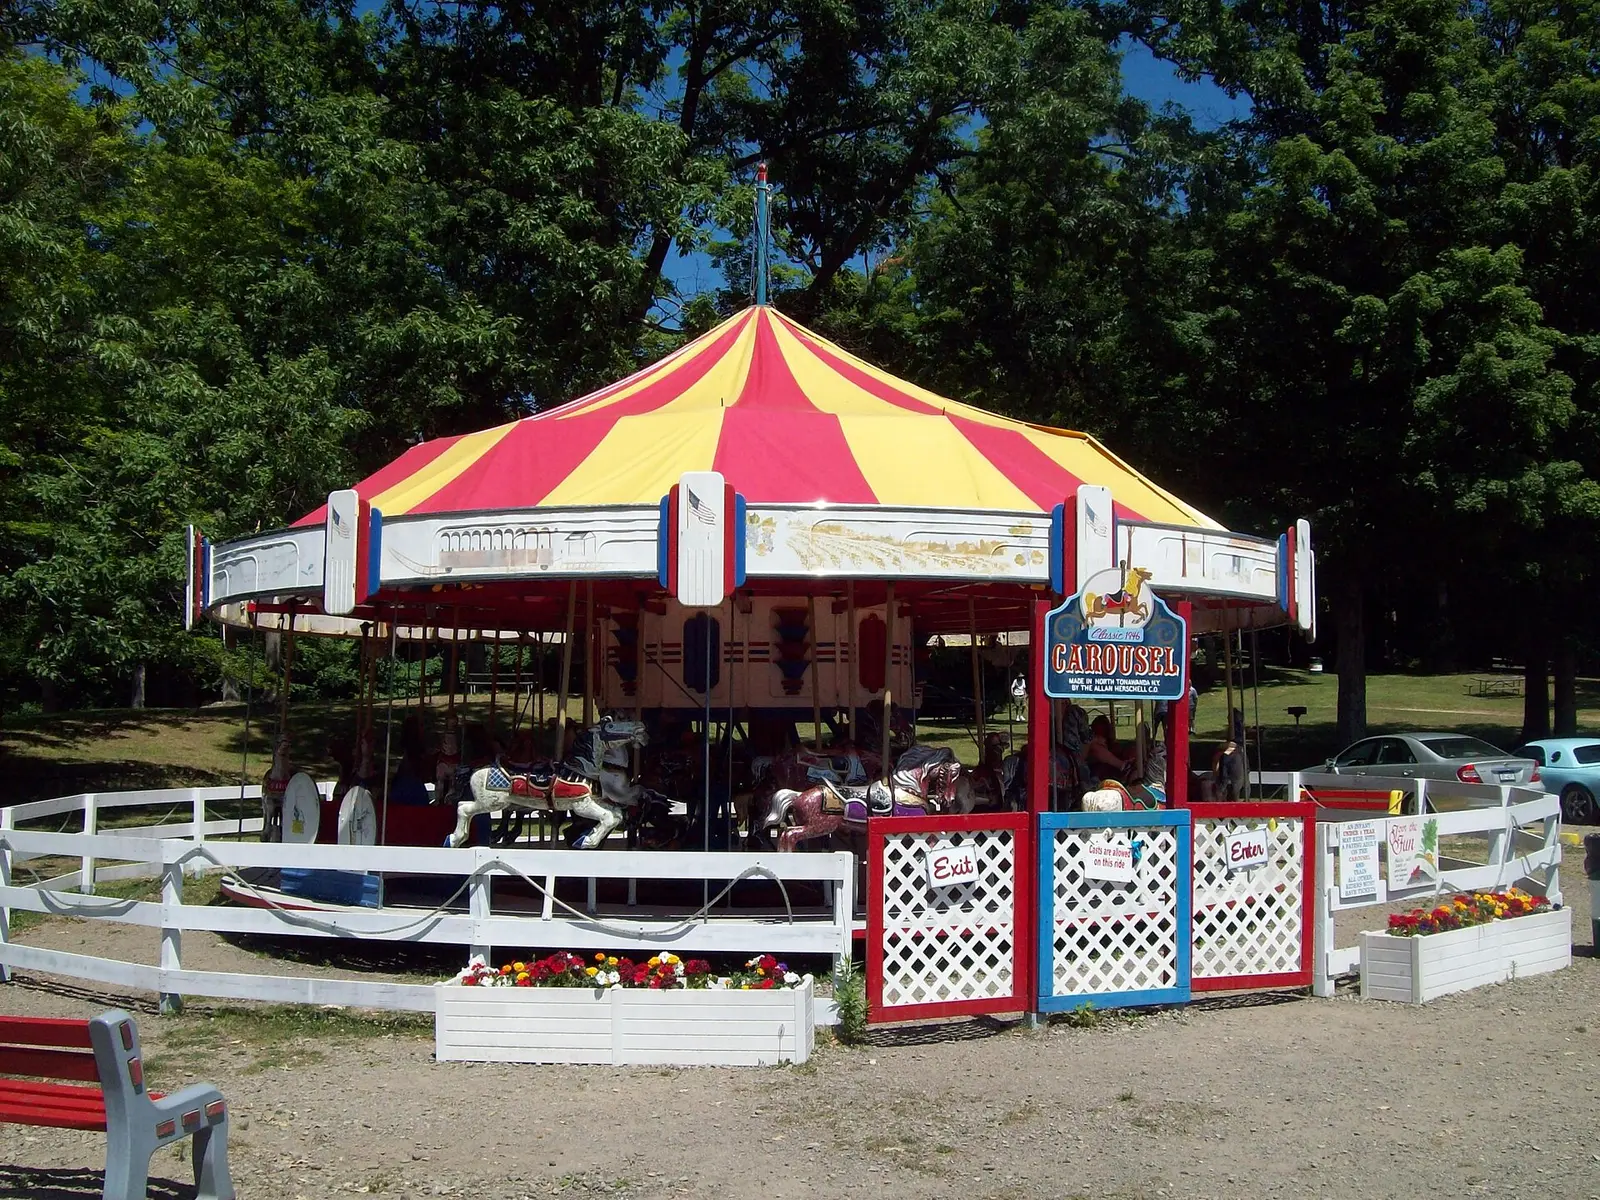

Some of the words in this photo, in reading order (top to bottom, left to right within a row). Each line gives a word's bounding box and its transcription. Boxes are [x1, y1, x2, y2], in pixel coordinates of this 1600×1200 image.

[1091, 628, 1123, 640] Classic
[1125, 631, 1141, 640] 1946
[1052, 643, 1180, 677] CAROUSEL
[1116, 678, 1150, 686] TONAWANDA
[1104, 848, 1112, 856] are
[1112, 847, 1131, 858] allowed
[1231, 841, 1264, 862] Enter
[1392, 835, 1415, 856] Fun
[934, 855, 974, 880] Exit
[1094, 858, 1102, 866] on
[1102, 858, 1114, 868] this
[1114, 859, 1126, 869] ride
